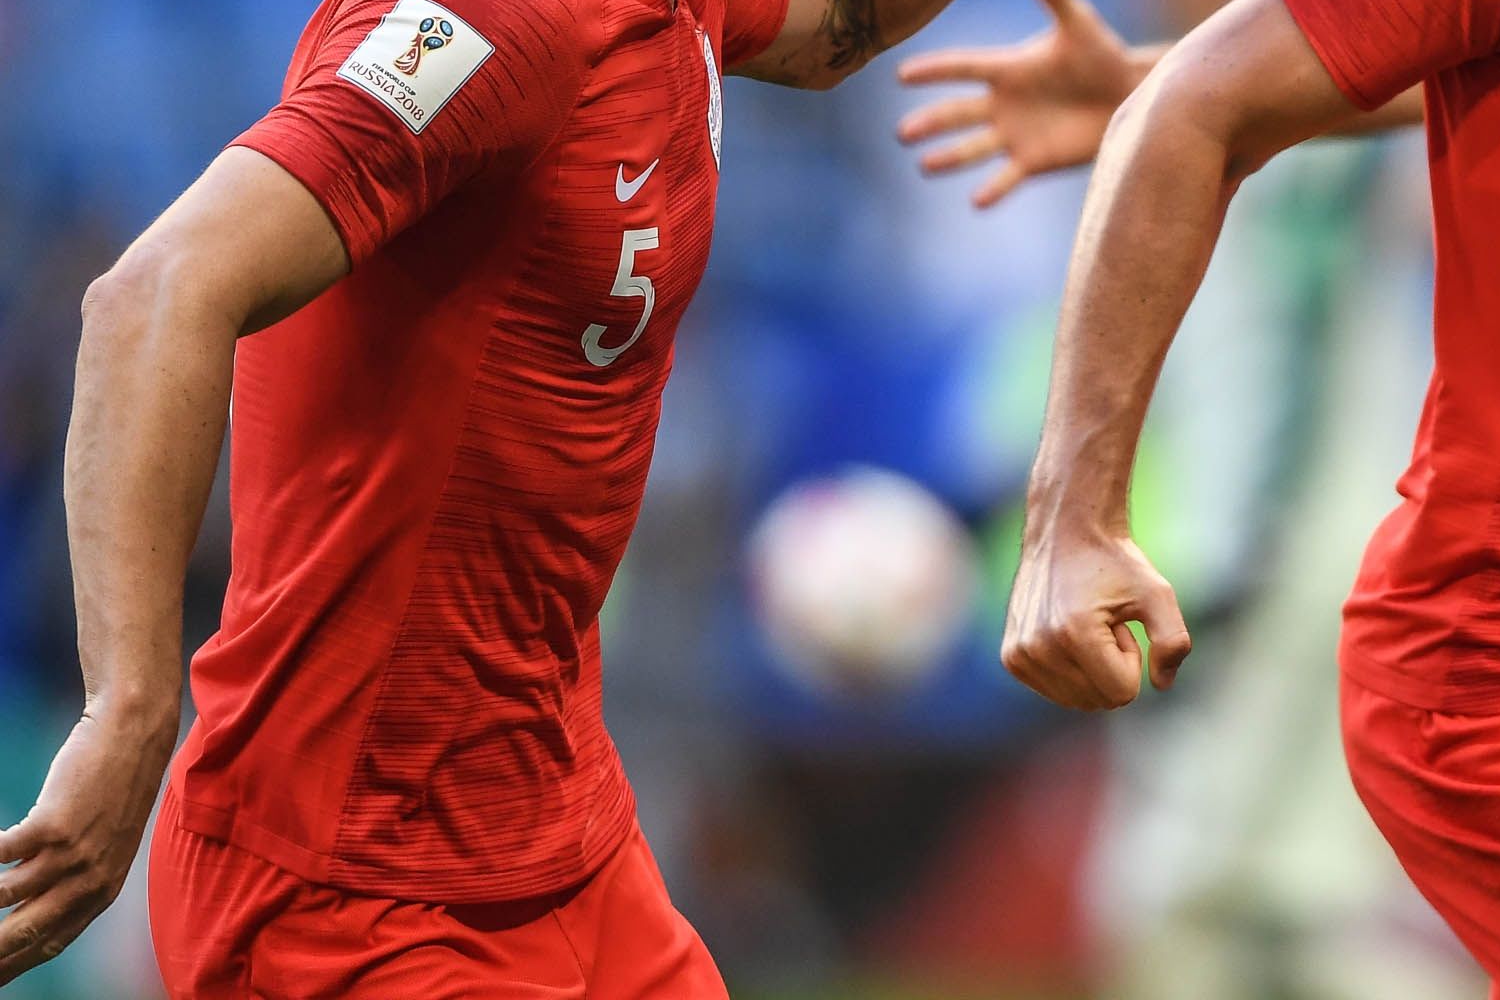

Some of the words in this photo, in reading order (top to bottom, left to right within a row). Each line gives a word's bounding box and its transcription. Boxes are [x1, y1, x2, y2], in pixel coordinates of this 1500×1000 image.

[348, 61, 395, 96] RUSSIA
[394, 91, 425, 121] 2018
[384, 71, 406, 88] WORLD
[580, 226, 660, 367] 5
